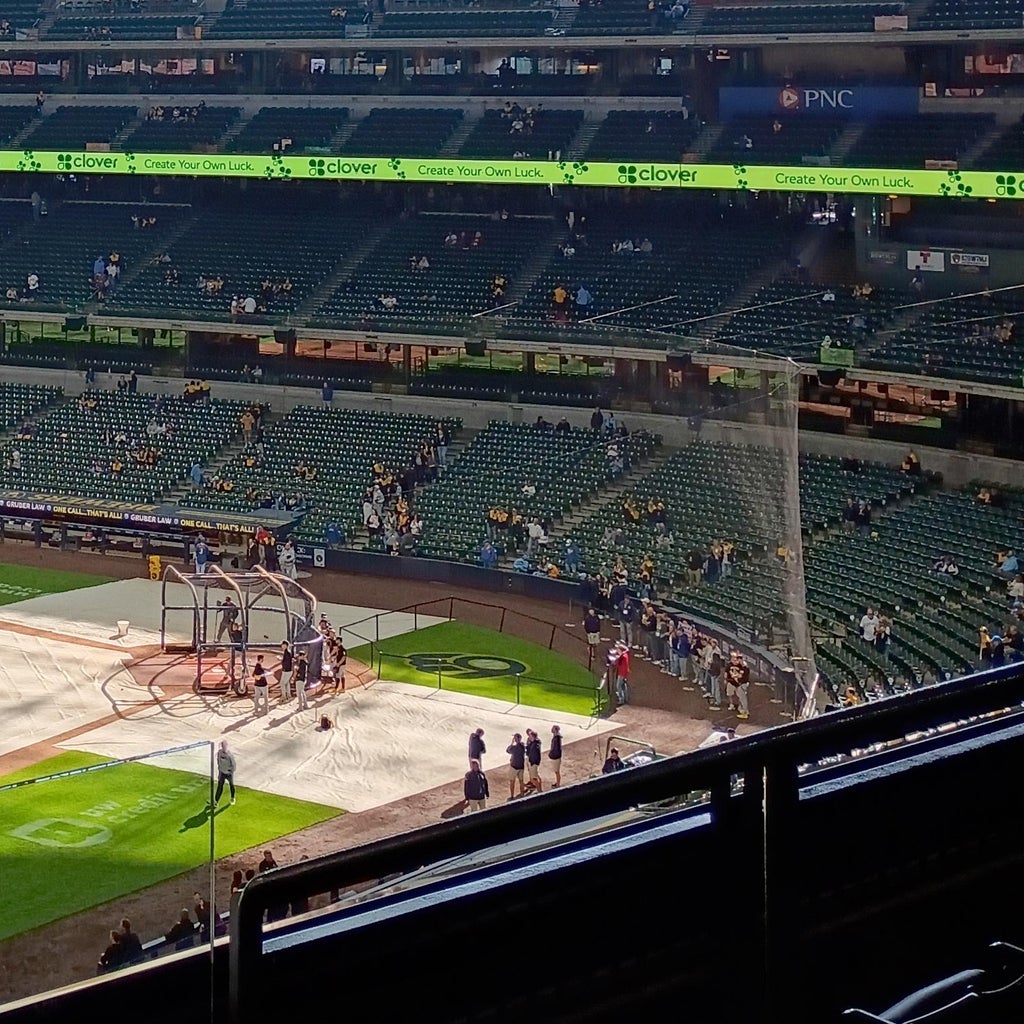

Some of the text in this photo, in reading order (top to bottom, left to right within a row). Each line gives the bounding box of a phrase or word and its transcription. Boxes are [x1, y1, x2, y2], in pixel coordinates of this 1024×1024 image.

[803, 89, 854, 108] PNC
[73, 154, 118, 168] clover
[144, 159, 255, 171] Create Your Own Luck.
[327, 160, 377, 174] clover
[418, 165, 544, 178] Create Your Own Luck.
[639, 166, 697, 182] clover
[775, 172, 914, 188] Create Your Own Luck.
[6, 500, 45, 511] GRUBER LAW
[53, 506, 68, 514] ONE
[130, 514, 156, 524] GRUBER
[180, 519, 195, 527] ONE
